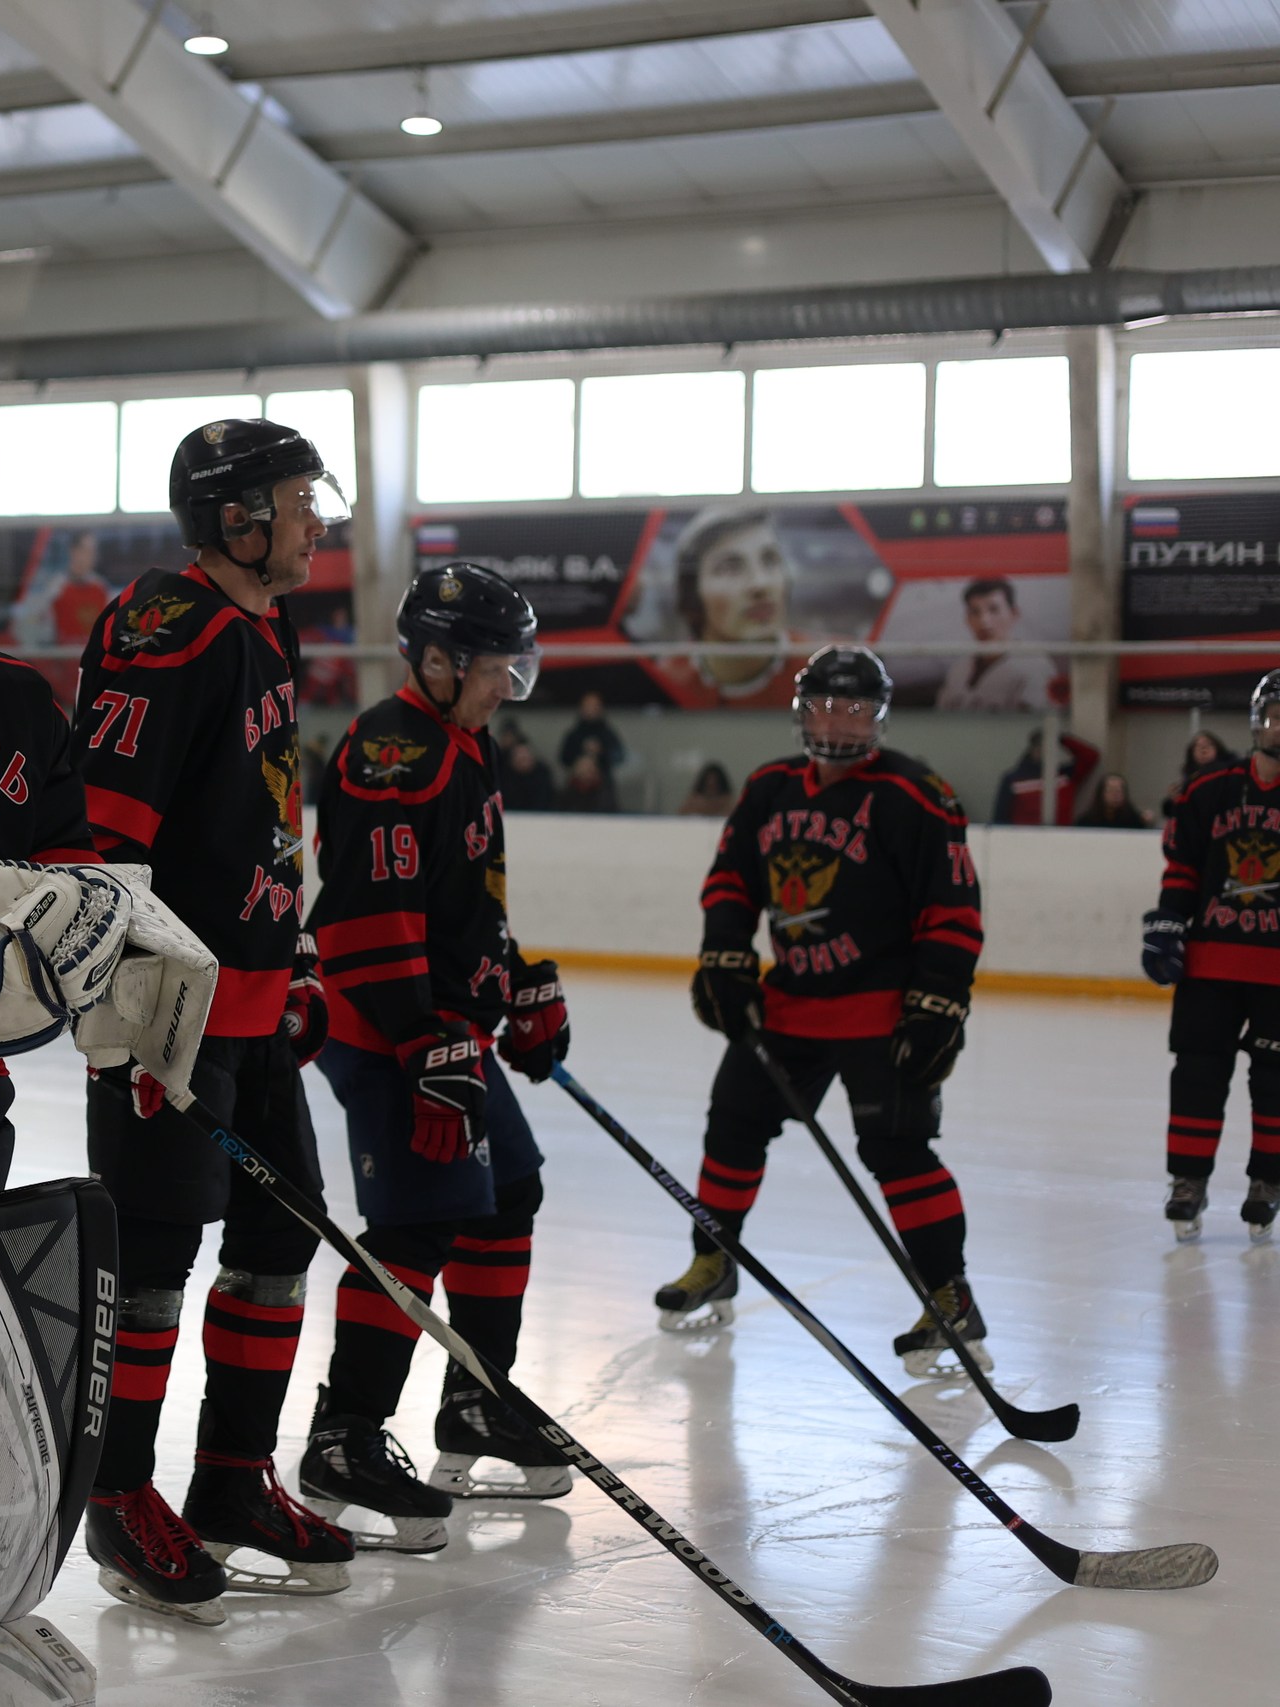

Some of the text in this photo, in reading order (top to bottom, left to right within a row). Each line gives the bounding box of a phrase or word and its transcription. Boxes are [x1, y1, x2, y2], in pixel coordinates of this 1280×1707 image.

[190, 463, 233, 481] BAUER
[1129, 541, 1264, 569] ПУТИН
[88, 689, 151, 759] 71
[370, 824, 420, 882] 19
[757, 808, 869, 864] ВИТЯЗЬ
[24, 891, 57, 930] BAUER
[162, 980, 188, 1064] BAUER
[82, 1266, 116, 1439] BAUER
[20, 1380, 52, 1467] SUPREME
[538, 1423, 755, 1607] SHER-WOOD
